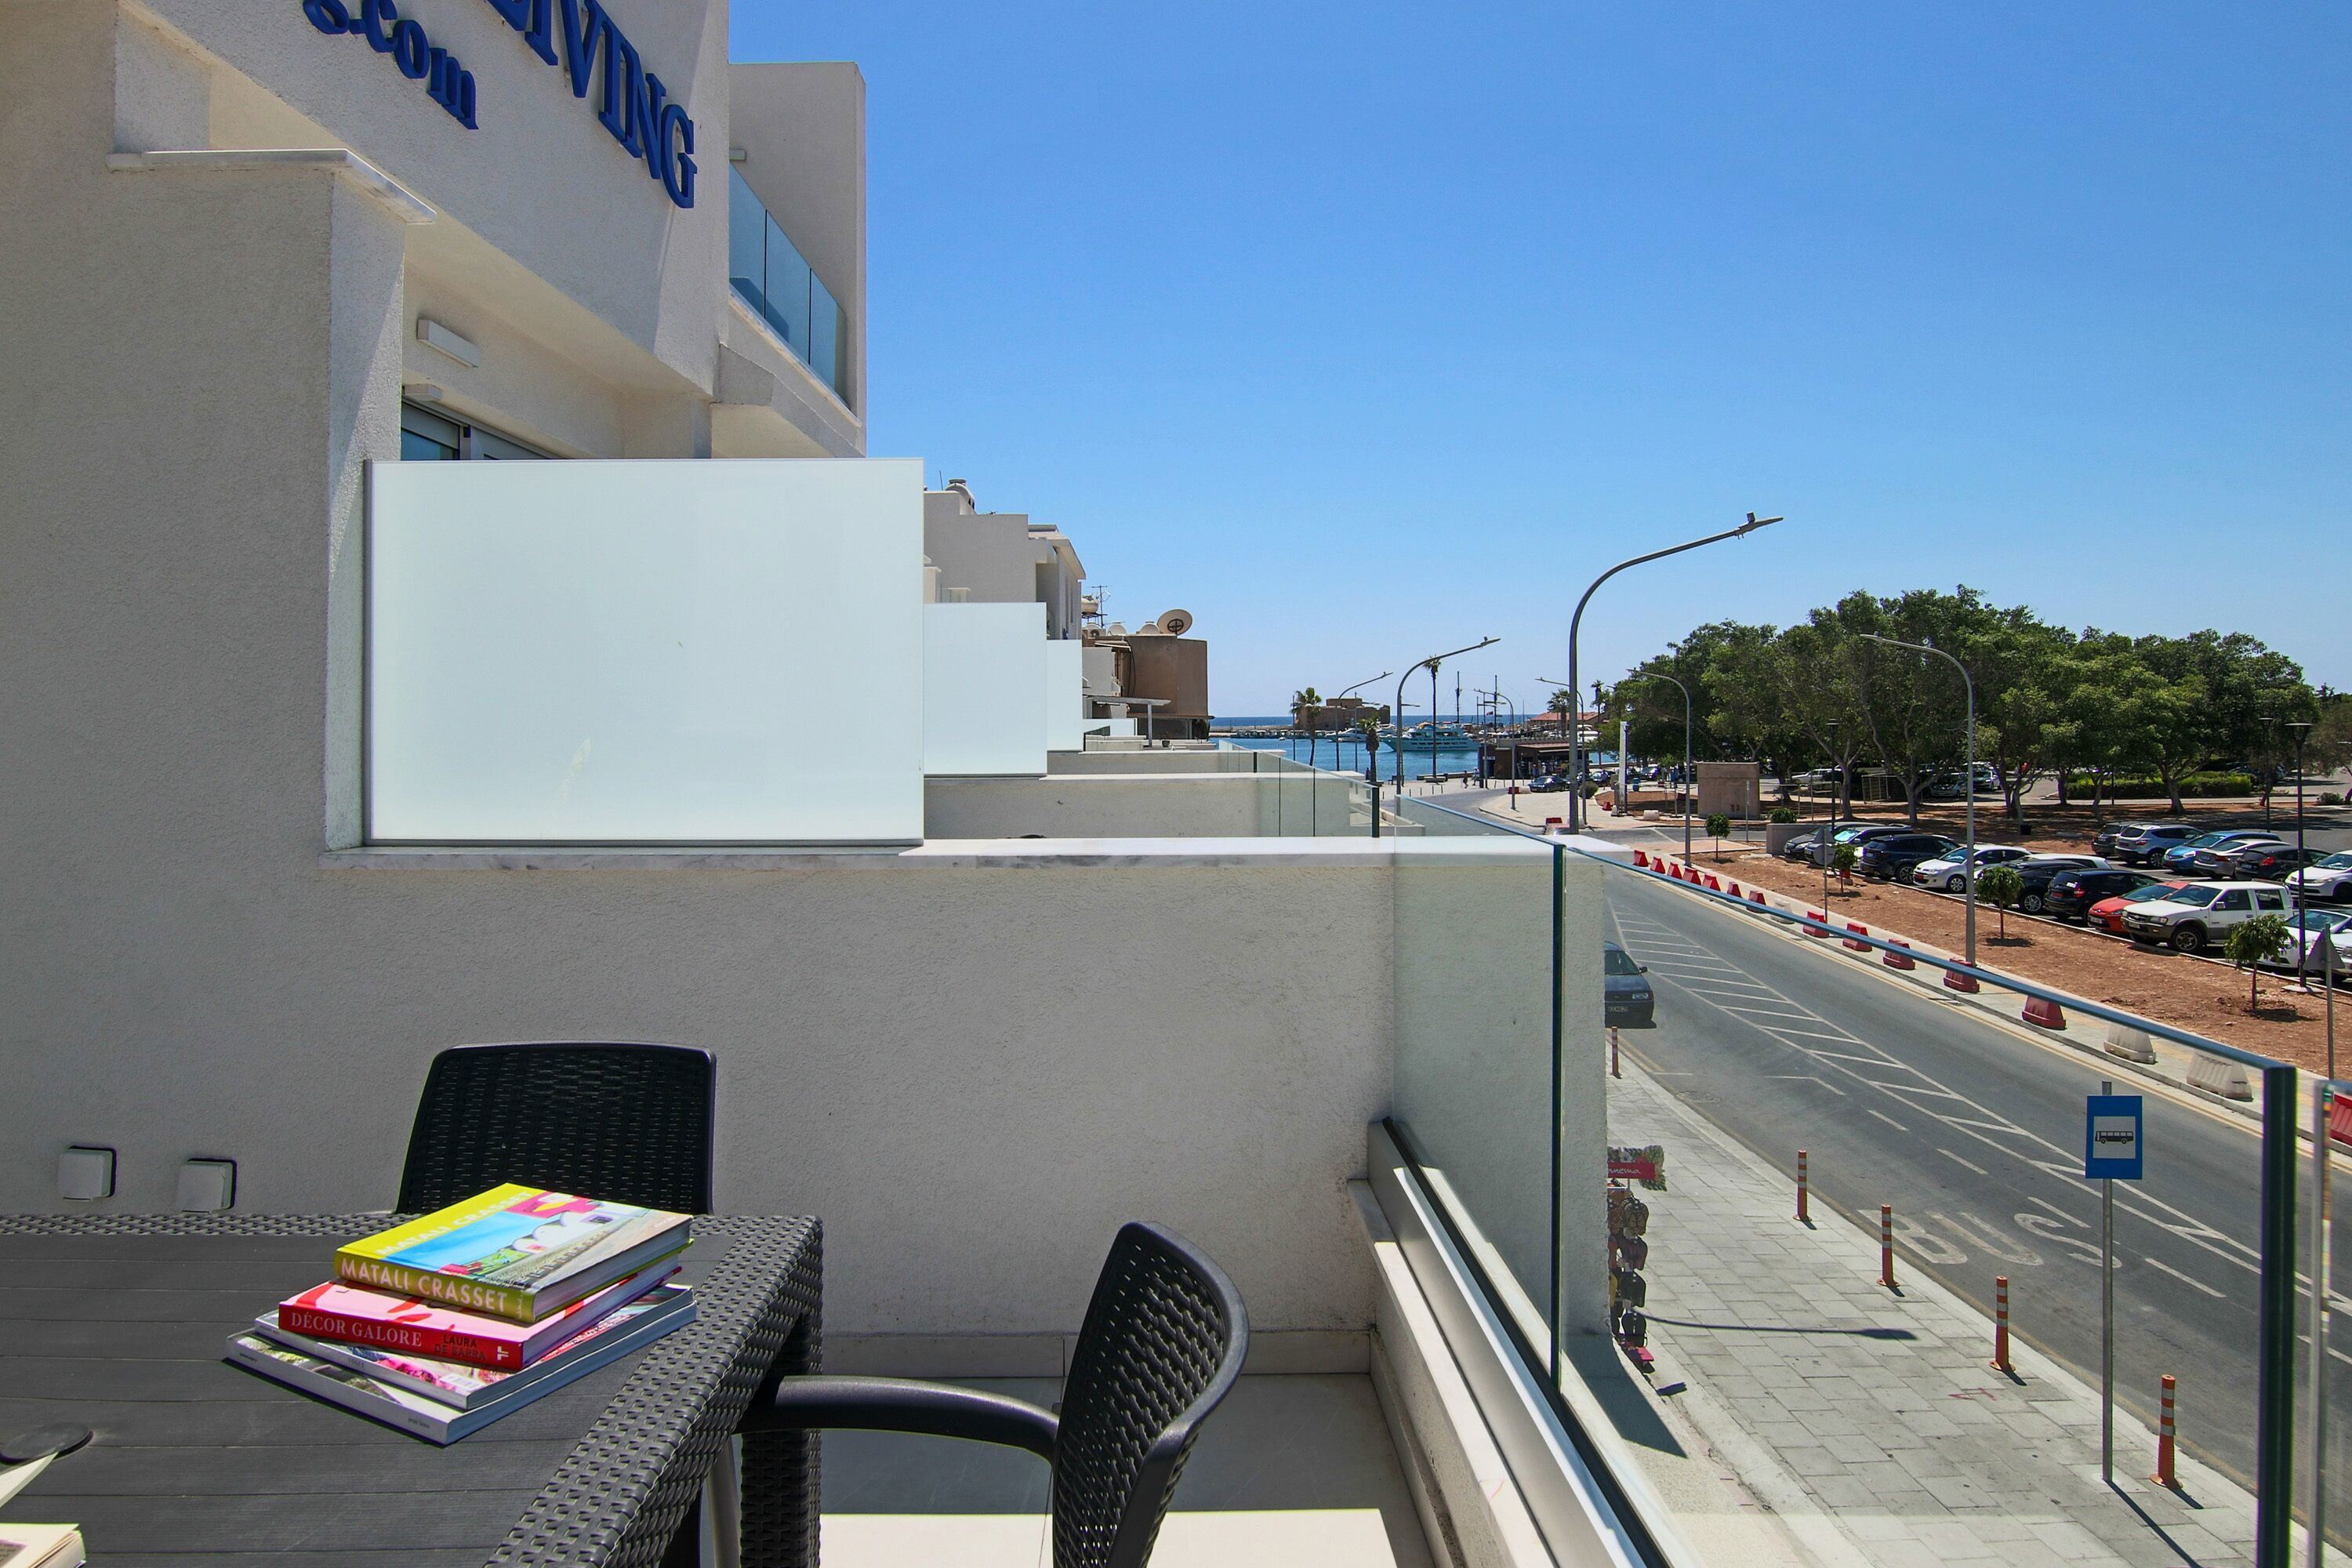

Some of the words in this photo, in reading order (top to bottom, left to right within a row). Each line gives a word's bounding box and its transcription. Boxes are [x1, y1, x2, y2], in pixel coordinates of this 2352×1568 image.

[375, 1225, 452, 1256] MATALI
[452, 1191, 532, 1226] CRASSET
[1857, 1209, 2122, 1269] BUS
[340, 1257, 409, 1291] MATALI
[417, 1275, 508, 1312] CRASSET
[291, 1311, 347, 1335] DÉCOR
[352, 1321, 423, 1348] GALORE
[434, 1344, 448, 1354] DE
[451, 1346, 487, 1360] BARRA
[442, 1334, 478, 1348] LAURA
